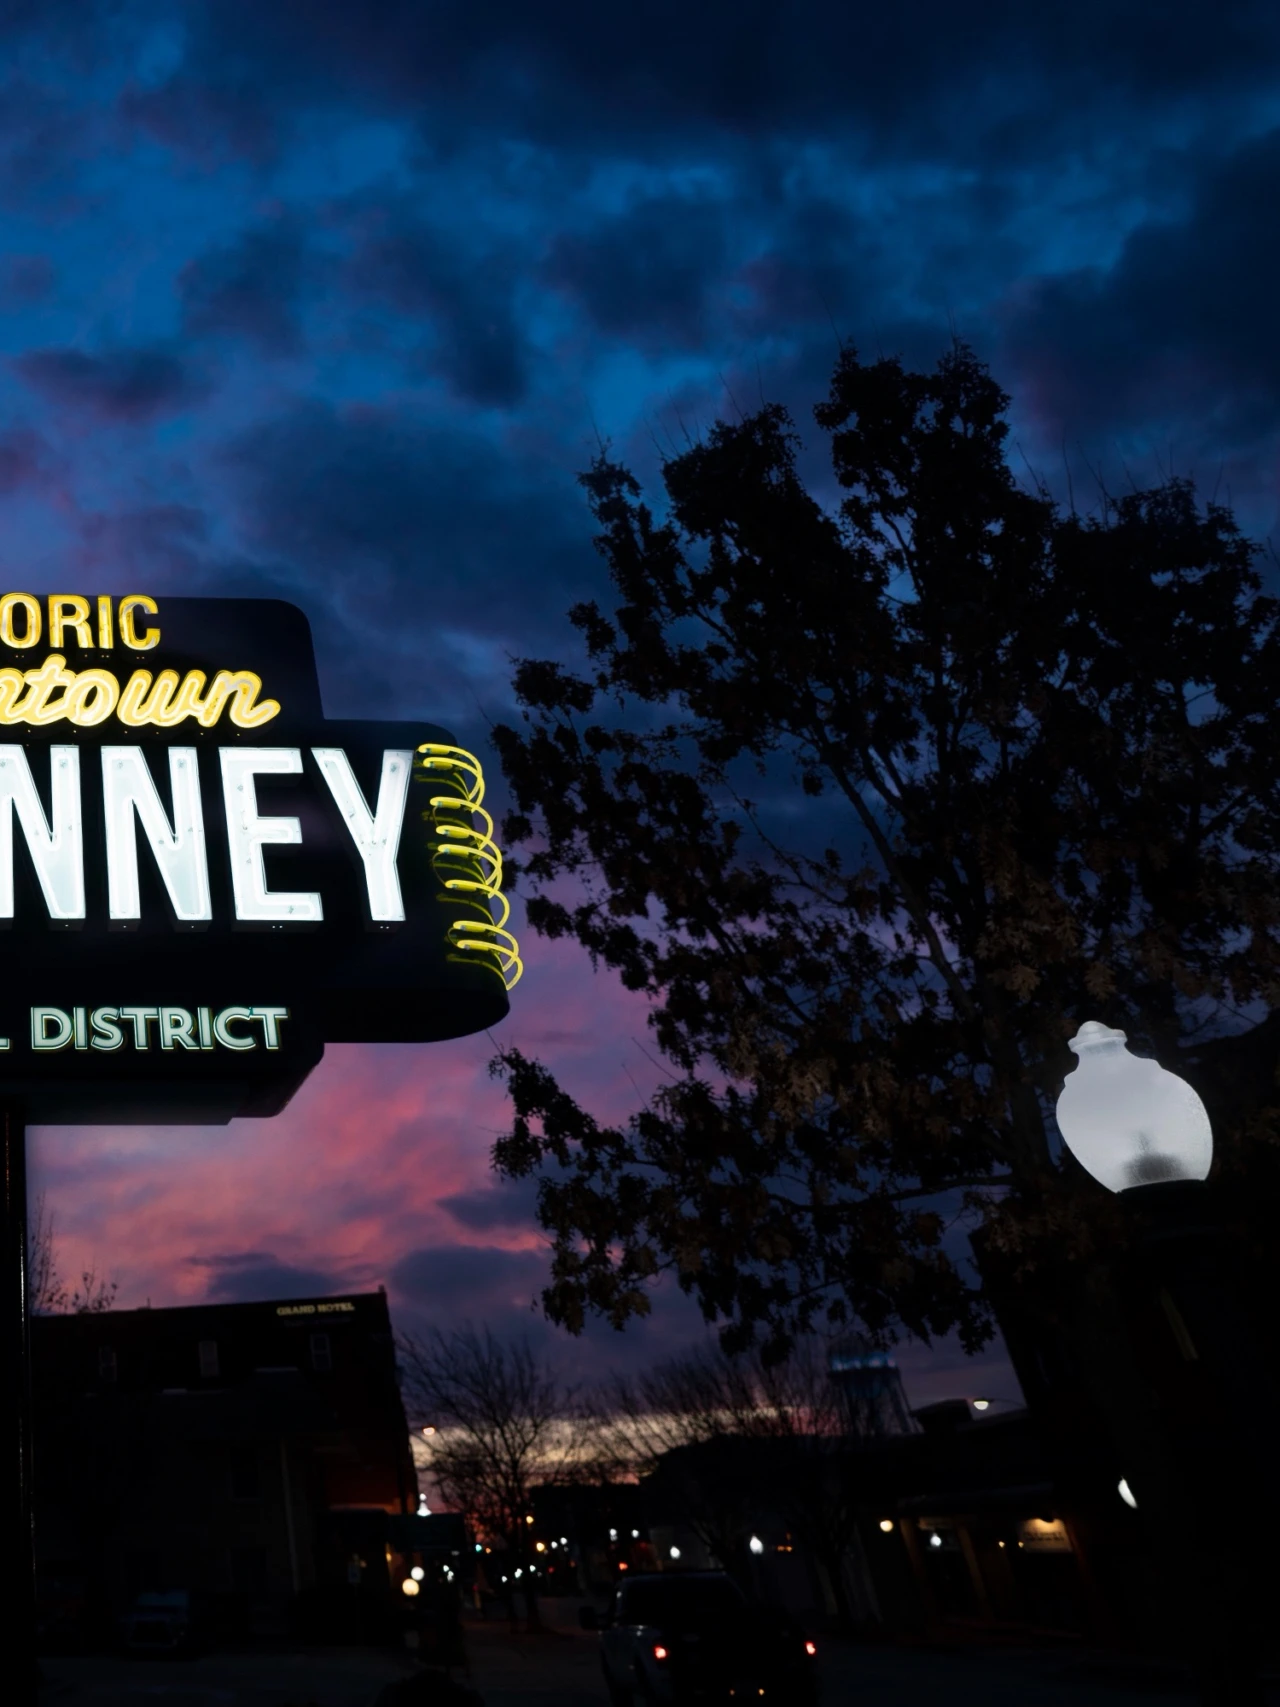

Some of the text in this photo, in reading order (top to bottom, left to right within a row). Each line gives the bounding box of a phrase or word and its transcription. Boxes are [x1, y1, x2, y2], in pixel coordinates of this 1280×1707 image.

[30, 1006, 289, 1052] DISTRICT
[276, 1301, 356, 1316] GRAND HOTEL
